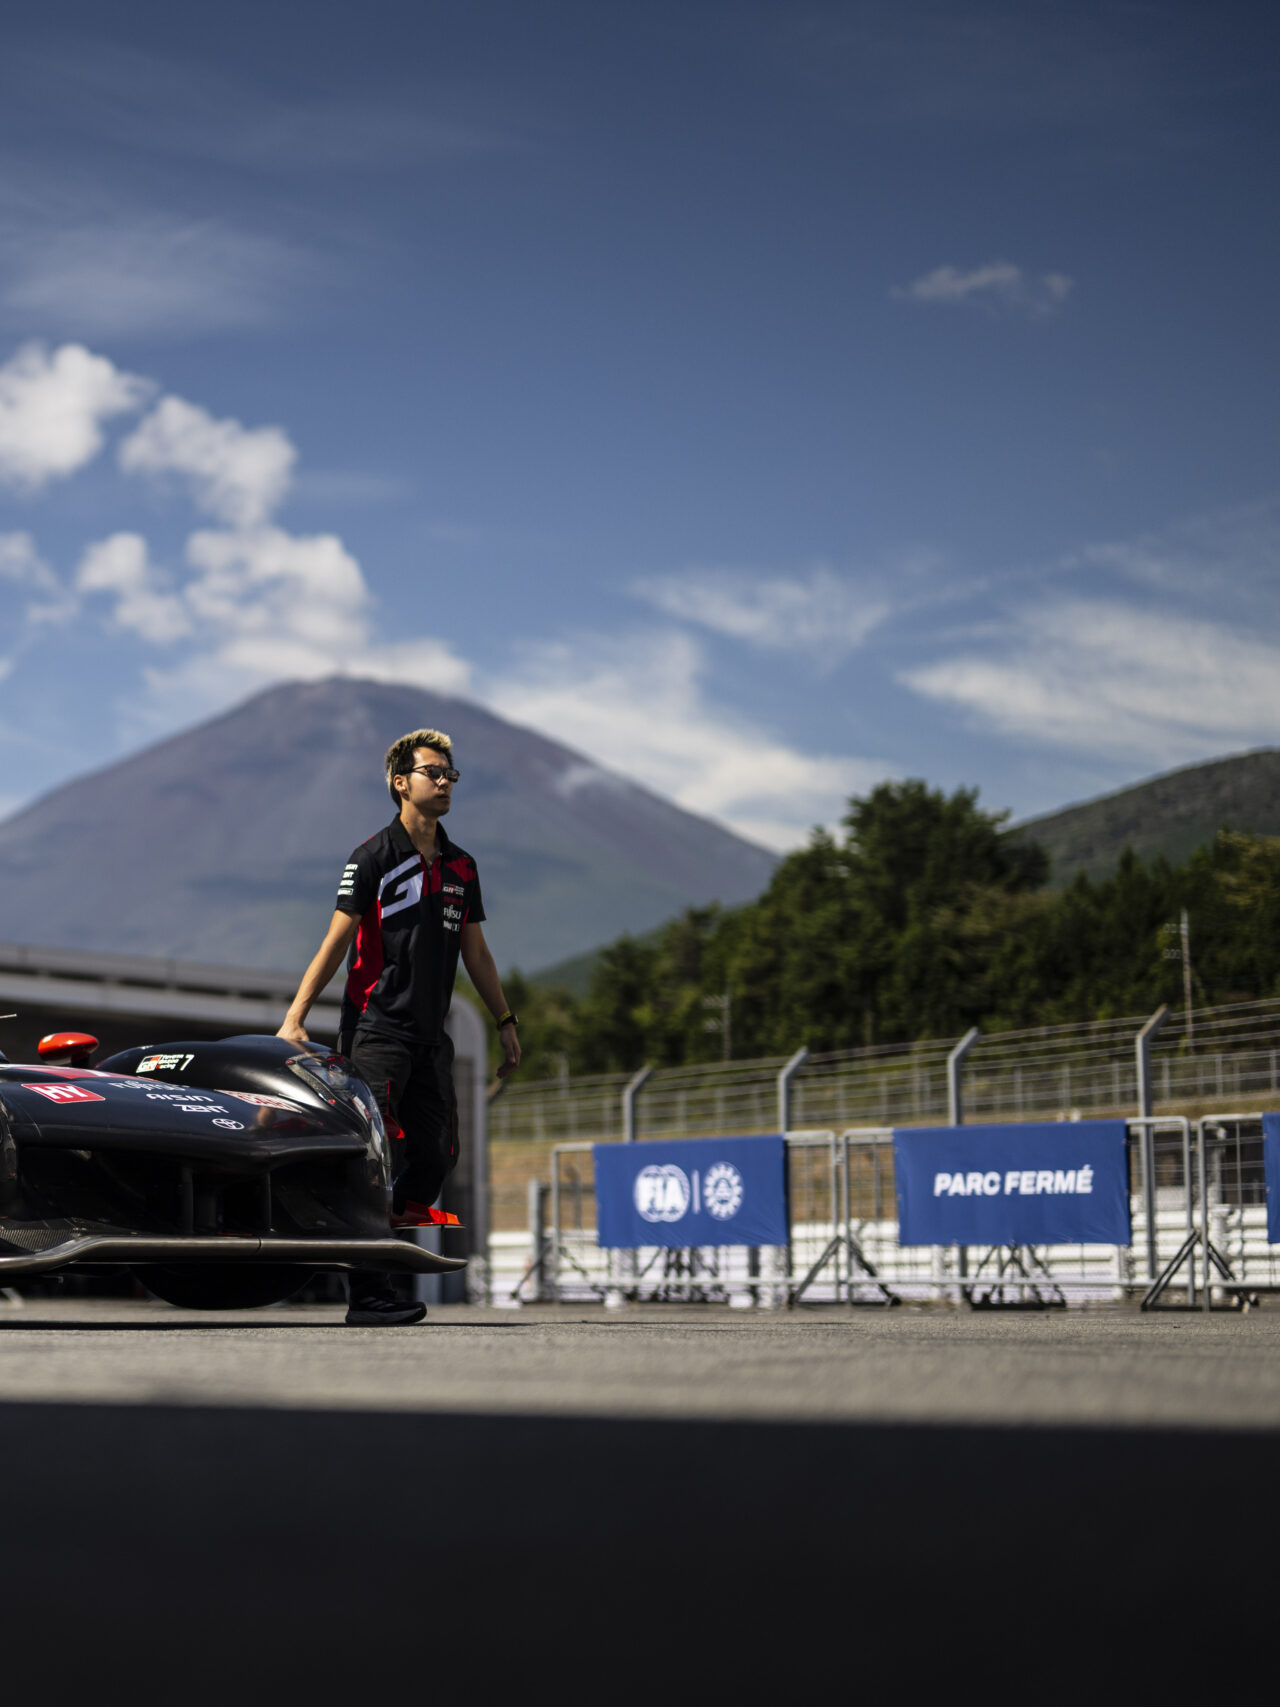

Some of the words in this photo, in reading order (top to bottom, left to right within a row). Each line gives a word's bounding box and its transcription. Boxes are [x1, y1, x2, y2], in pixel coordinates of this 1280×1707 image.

[180, 1053, 195, 1071] 7
[33, 1084, 88, 1100] HY
[145, 1093, 215, 1102] AISIN
[172, 1103, 230, 1114] ZENT
[934, 1172, 1001, 1197] PARC
[1004, 1164, 1094, 1195] FERMÉ
[635, 1174, 687, 1213] FIA
